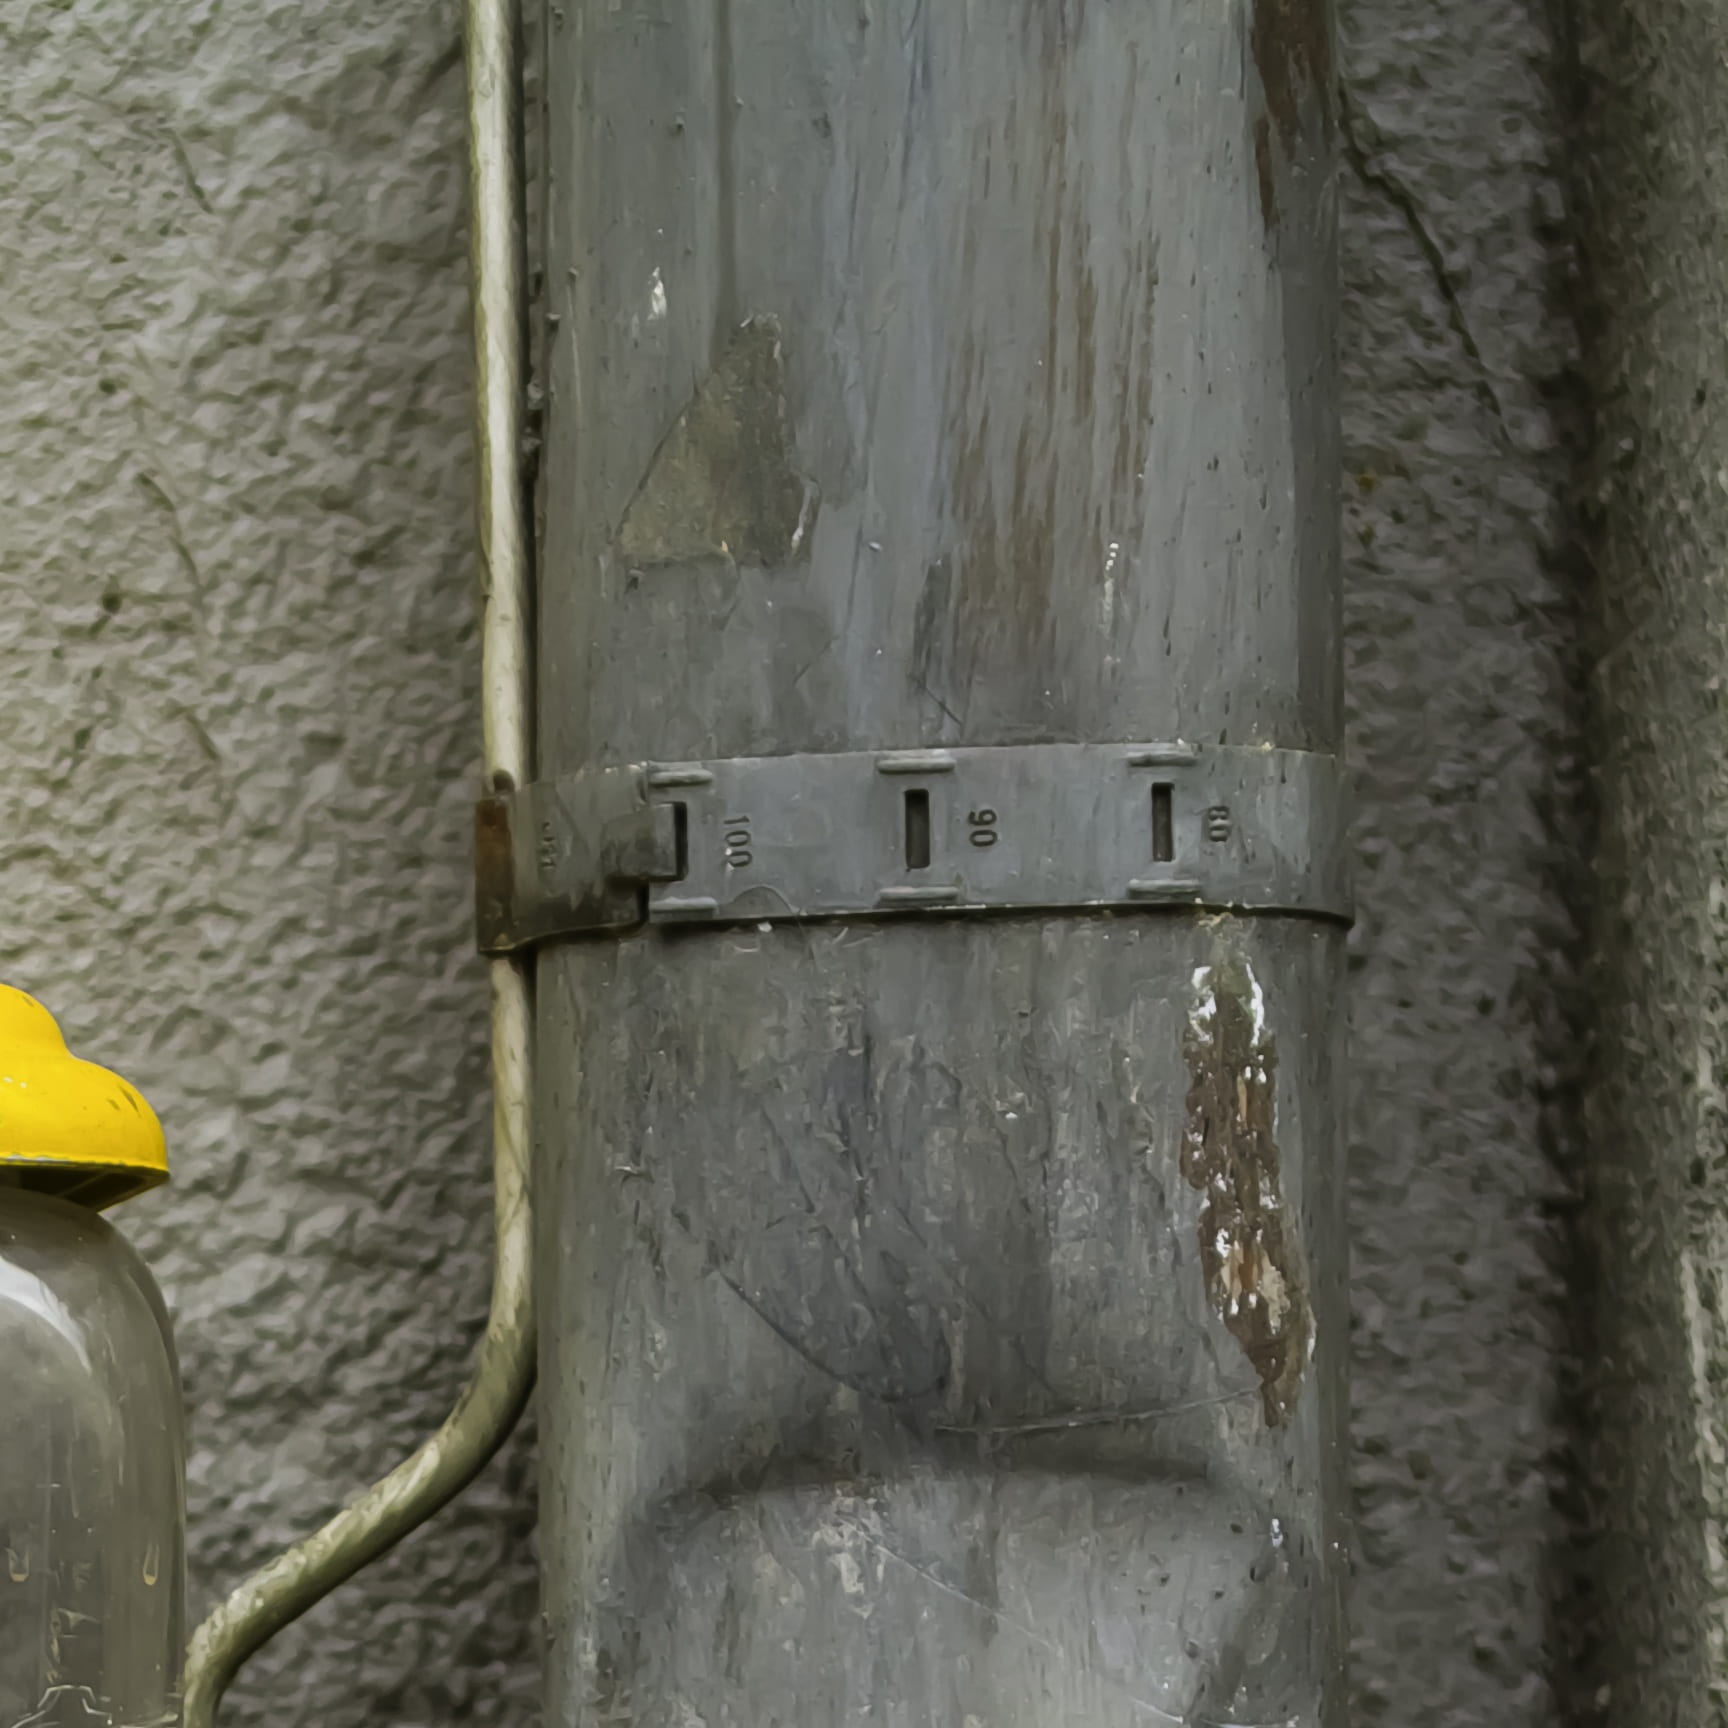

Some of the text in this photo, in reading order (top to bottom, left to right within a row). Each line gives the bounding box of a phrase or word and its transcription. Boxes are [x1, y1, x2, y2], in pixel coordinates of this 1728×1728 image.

[723, 815, 753, 869] 100
[968, 809, 998, 848] 90
[1207, 806, 1232, 842] 80
